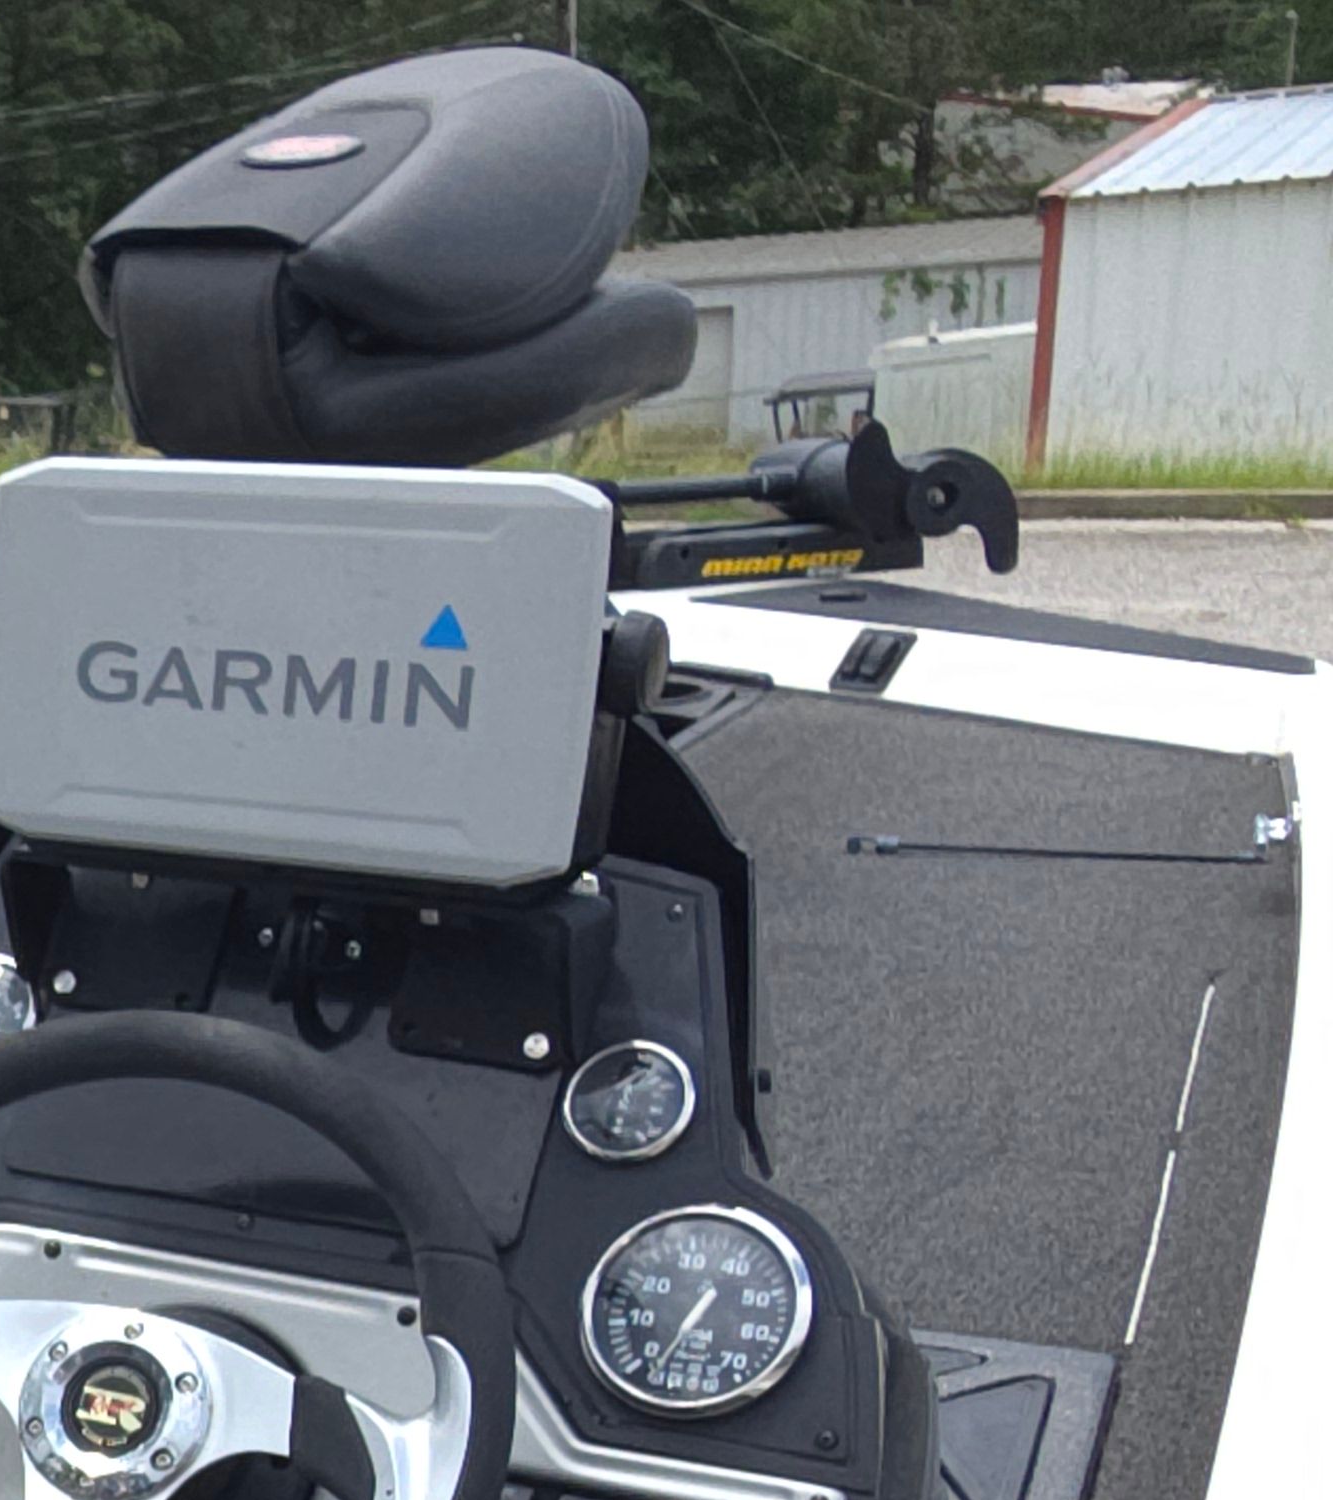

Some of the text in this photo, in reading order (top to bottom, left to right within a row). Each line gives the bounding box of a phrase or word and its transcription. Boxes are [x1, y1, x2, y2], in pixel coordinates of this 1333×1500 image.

[77, 641, 474, 731] GARMIN
[678, 1253, 707, 1271] 30
[721, 1259, 751, 1277] 40
[642, 1276, 671, 1294] 20
[741, 1289, 770, 1308] 50
[629, 1308, 654, 1326] 10
[740, 1322, 770, 1342] 60
[644, 1341, 660, 1358] 0
[720, 1350, 748, 1370] 70
